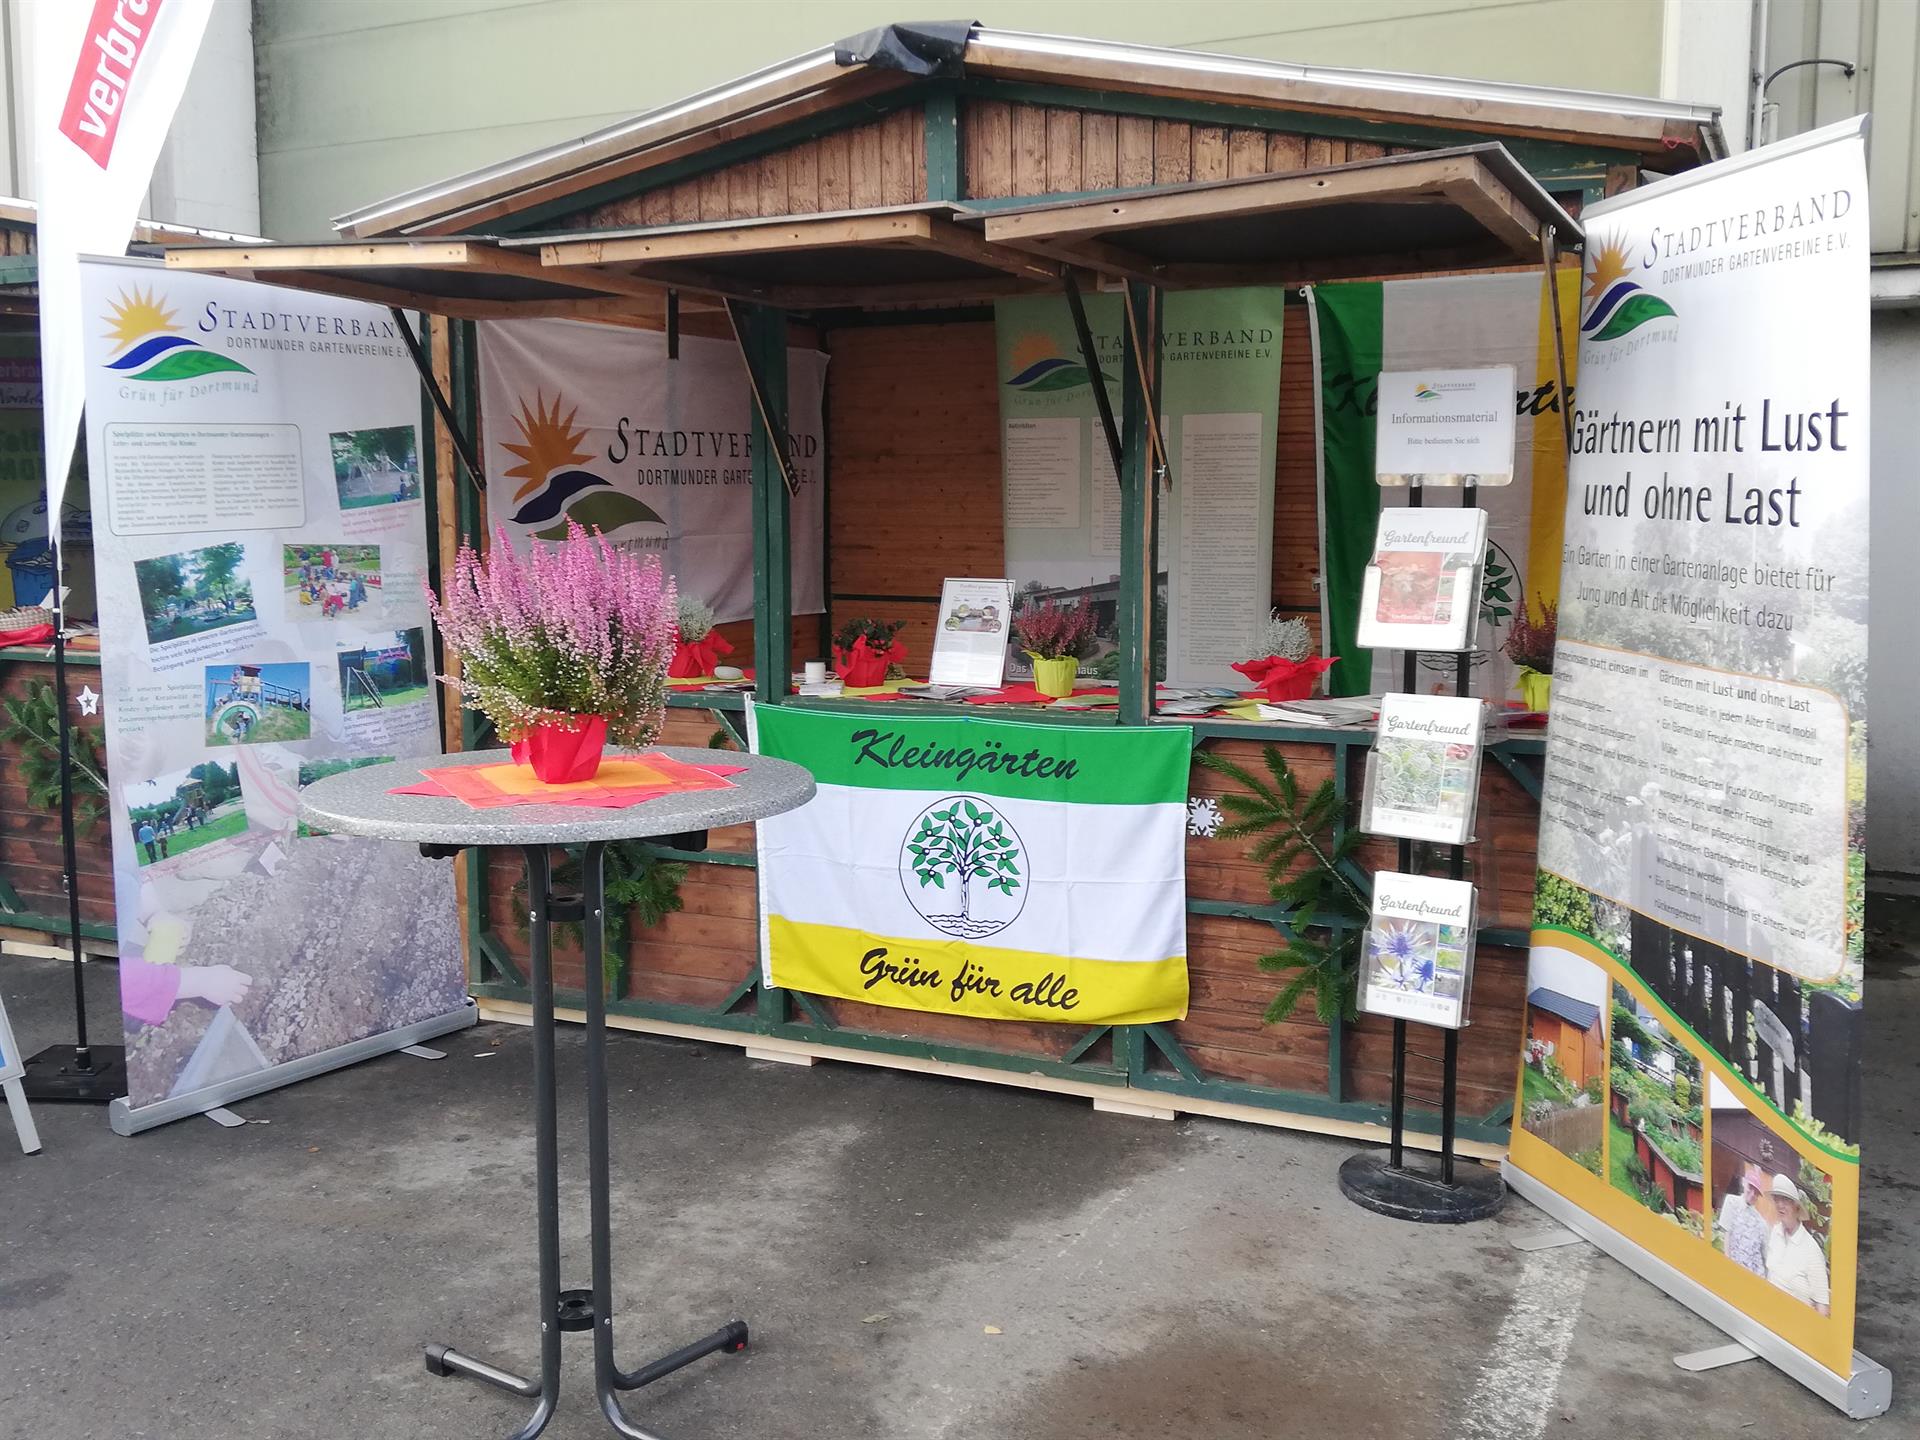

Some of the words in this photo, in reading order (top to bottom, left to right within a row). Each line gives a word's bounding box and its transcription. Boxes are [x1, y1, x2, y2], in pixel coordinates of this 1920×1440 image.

[1643, 189, 1852, 270] STADTVERBAND
[1663, 257, 1724, 285] DORTMUNDER
[1729, 238, 1822, 271] GARTENVEREINE
[1827, 232, 1850, 252] E.V.
[199, 301, 404, 340] STADTVERBAN
[227, 337, 304, 352] DORTMUNDER
[310, 342, 393, 357] GARTENVEREINE
[1170, 350, 1250, 361] GARTENVEREINE
[1255, 349, 1272, 359] E.V.
[119, 386, 155, 401] Grün
[161, 387, 183, 406] für
[190, 380, 259, 398] Dortmund
[1392, 411, 1498, 424] Informationsmaterial
[1572, 409, 1681, 455] Gärtnern
[1693, 401, 1747, 453] mit
[1761, 398, 1849, 452] Lust
[638, 469, 717, 485] DORTMUNDER
[1584, 471, 1632, 517] und
[1644, 471, 1713, 522] ohne
[1725, 472, 1802, 527] Last
[1384, 530, 1469, 547] Gartenfreund
[1578, 545, 1611, 568] Garten
[1615, 549, 1626, 570] in
[1630, 551, 1660, 574] einer
[1662, 553, 1749, 588] Gartenanlage
[1754, 563, 1801, 590] bietet
[1805, 566, 1836, 593] für
[1576, 581, 1601, 608] Jung
[1604, 588, 1627, 607] und
[1630, 588, 1651, 610] Alt
[1652, 591, 1667, 613] die
[1670, 593, 1751, 626] Möglichkeit
[1756, 604, 1793, 631] dazu
[1010, 663, 1026, 673] Das
[1590, 656, 1607, 670] statt
[1609, 661, 1636, 676] einsam
[1659, 669, 1693, 689] Gärtnern
[1696, 679, 1710, 693] mit
[1713, 680, 1734, 698] Lust
[1737, 688, 1757, 701] und
[1760, 691, 1785, 707] ohne
[1788, 695, 1811, 713] Last
[1388, 715, 1471, 735] Gartenfreund
[1673, 698, 1695, 712] Garten
[1719, 709, 1742, 722] jedem
[1744, 714, 1764, 728] Alter
[1766, 718, 1775, 731] fit
[1776, 722, 1791, 735] und
[1792, 727, 1816, 740] mobil
[851, 729, 1080, 782] Kleingärten
[1672, 721, 1694, 736] Garten
[1707, 730, 1732, 746] Freude
[1734, 738, 1765, 754] machen
[1767, 745, 1782, 758] und
[1783, 748, 1804, 763] nicht
[1805, 755, 1823, 767] nur
[1698, 775, 1724, 790] Garten
[1707, 804, 1721, 815] und
[1723, 808, 1743, 820] mehr
[1745, 811, 1774, 829] Freizeit
[1668, 812, 1690, 829] Garten
[1691, 816, 1709, 834] kann
[1792, 852, 1809, 866] und
[1704, 847, 1758, 873] Gartengeräten
[1696, 870, 1724, 886] werden
[1379, 895, 1461, 917] Gartenfreund
[1665, 879, 1688, 897] Garten
[1705, 894, 1748, 918] Hochbeeten
[1789, 926, 1806, 940] und
[860, 948, 943, 990] Grün
[950, 960, 1004, 1003] für
[1010, 972, 1080, 1010] alle
